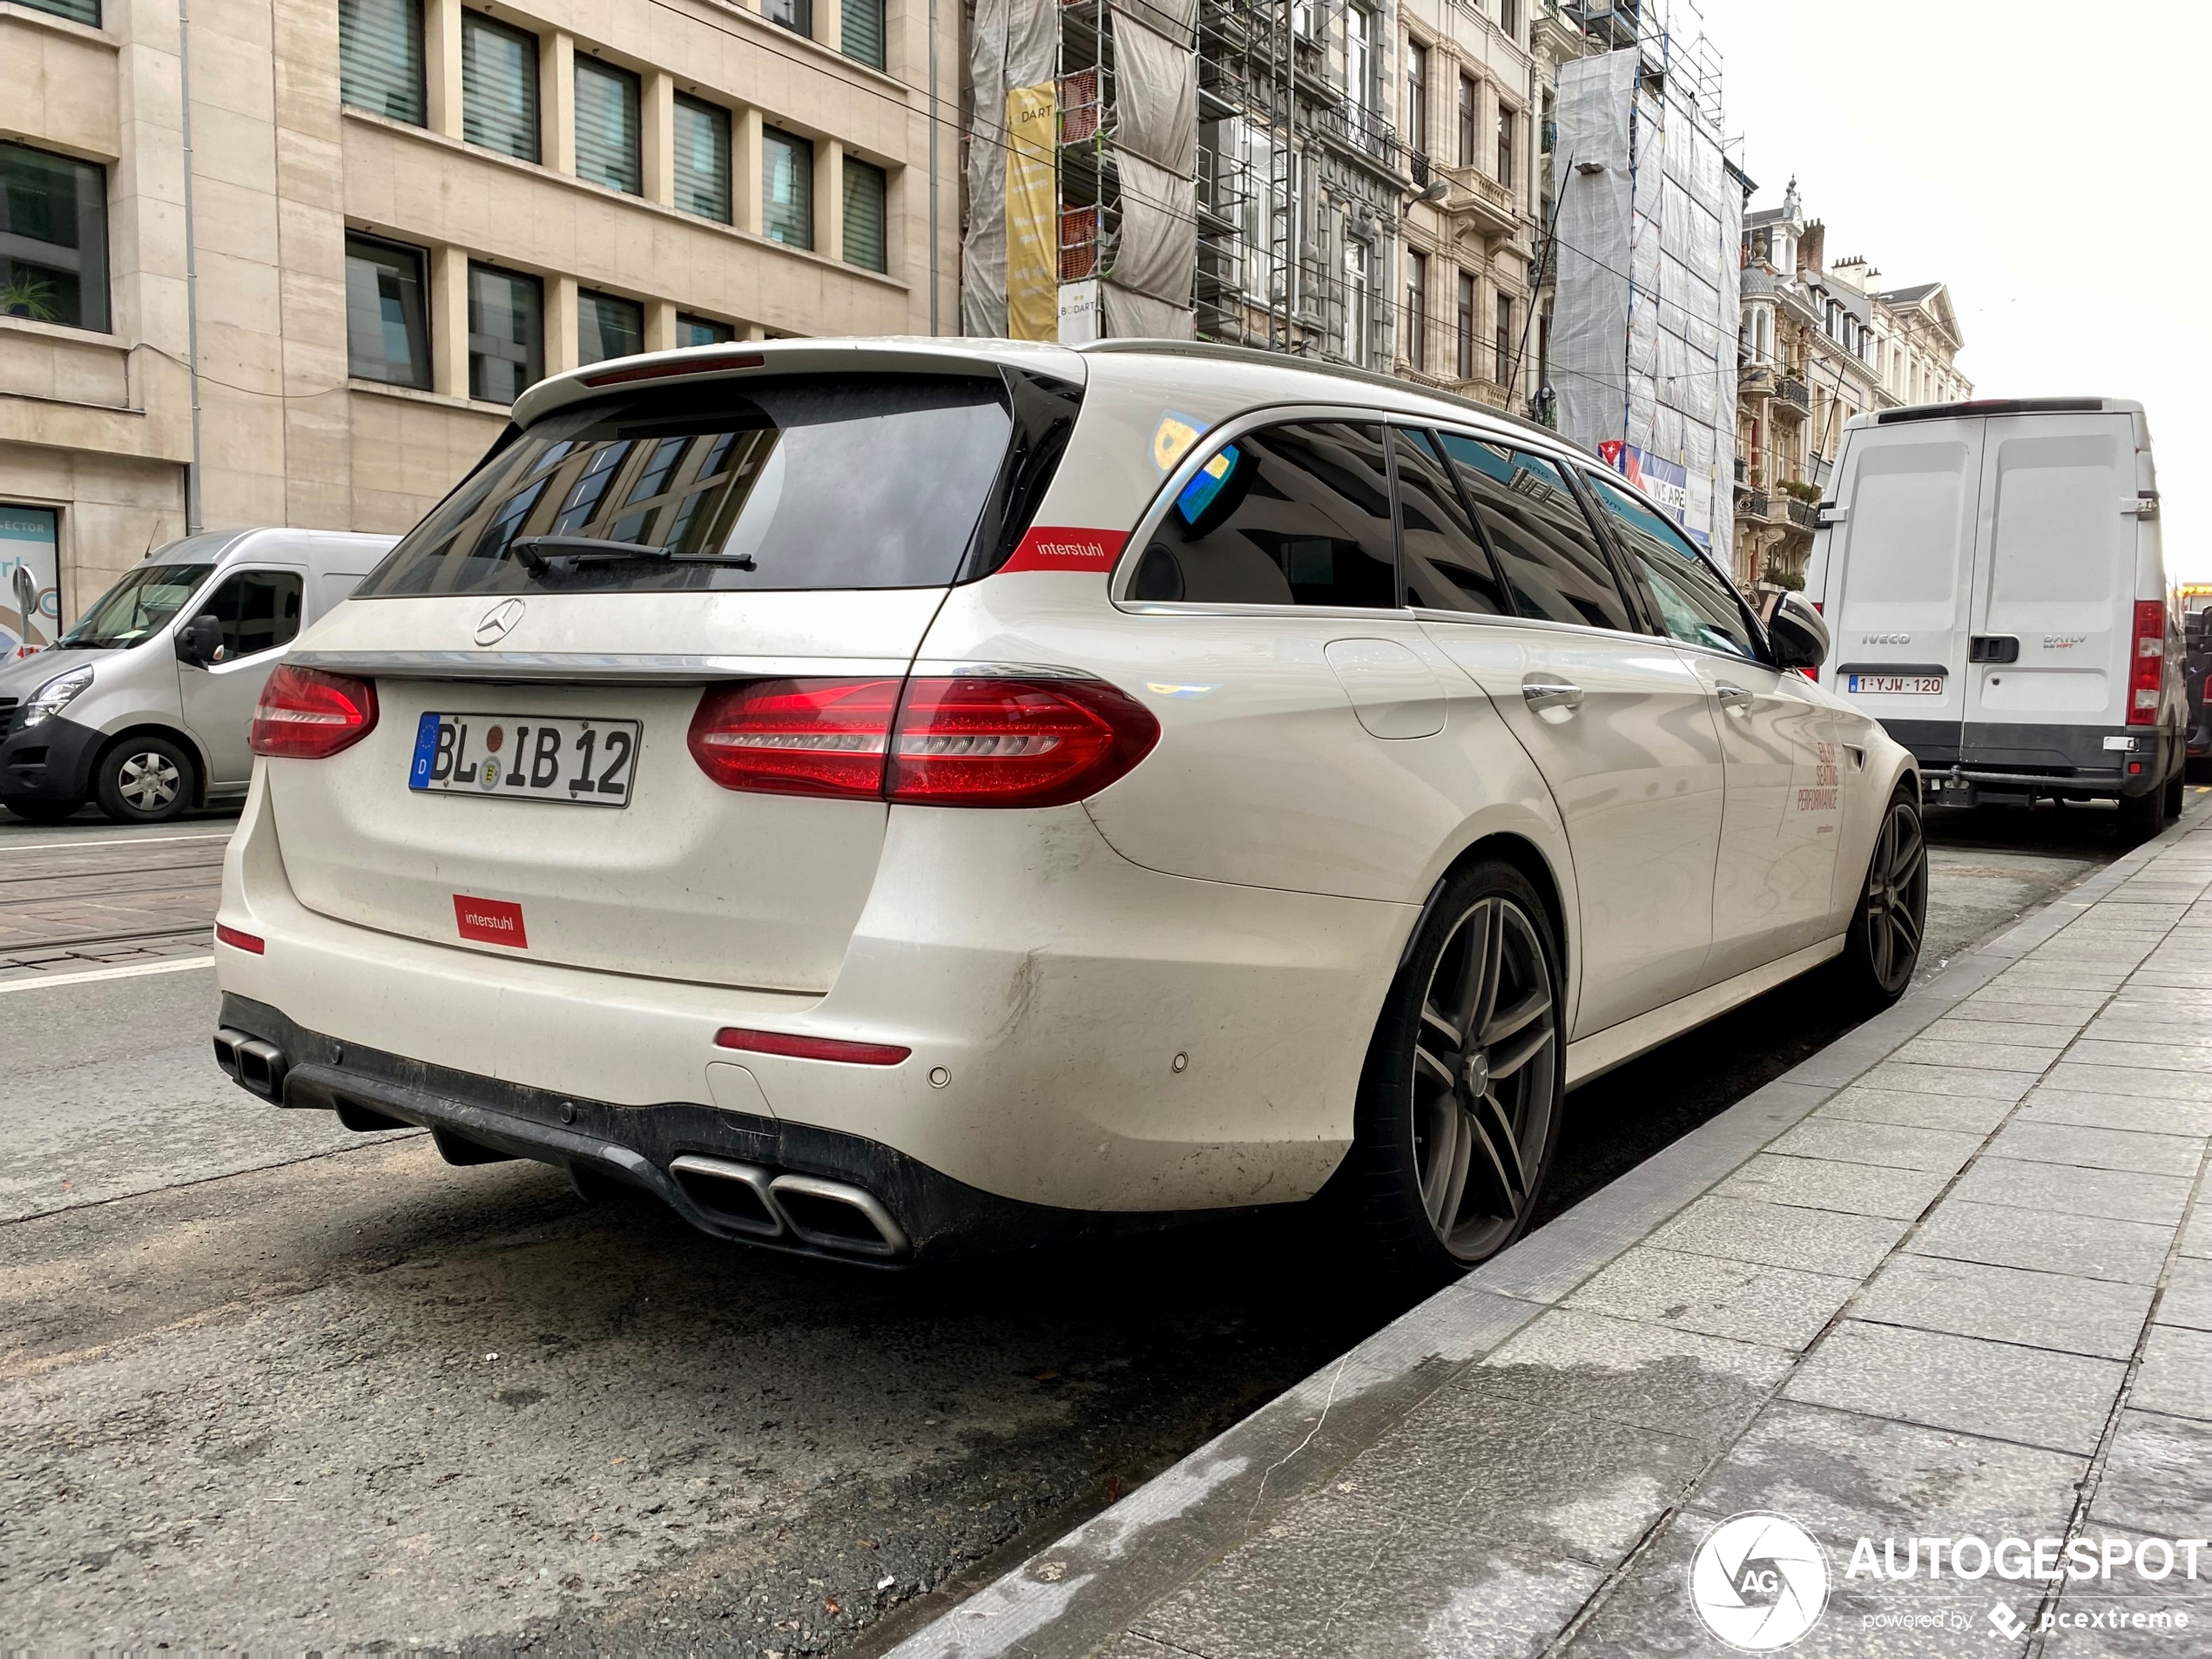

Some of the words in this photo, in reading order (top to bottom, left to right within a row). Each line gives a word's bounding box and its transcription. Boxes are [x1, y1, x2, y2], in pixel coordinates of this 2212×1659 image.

[1061, 301, 1096, 316] BODART
[0, 520, 44, 533] ECTOR
[1035, 540, 1105, 557] interstuhl
[1862, 633, 1911, 645] IVECO
[2043, 634, 2087, 644] DAILY
[429, 723, 478, 783] BL
[505, 725, 563, 788] IB
[568, 729, 632, 794] 12
[418, 759, 427, 775] D
[1816, 765, 1839, 787] SEATING
[1797, 788, 1838, 812] PERFORMANCE
[464, 909, 514, 931] interstuhl
